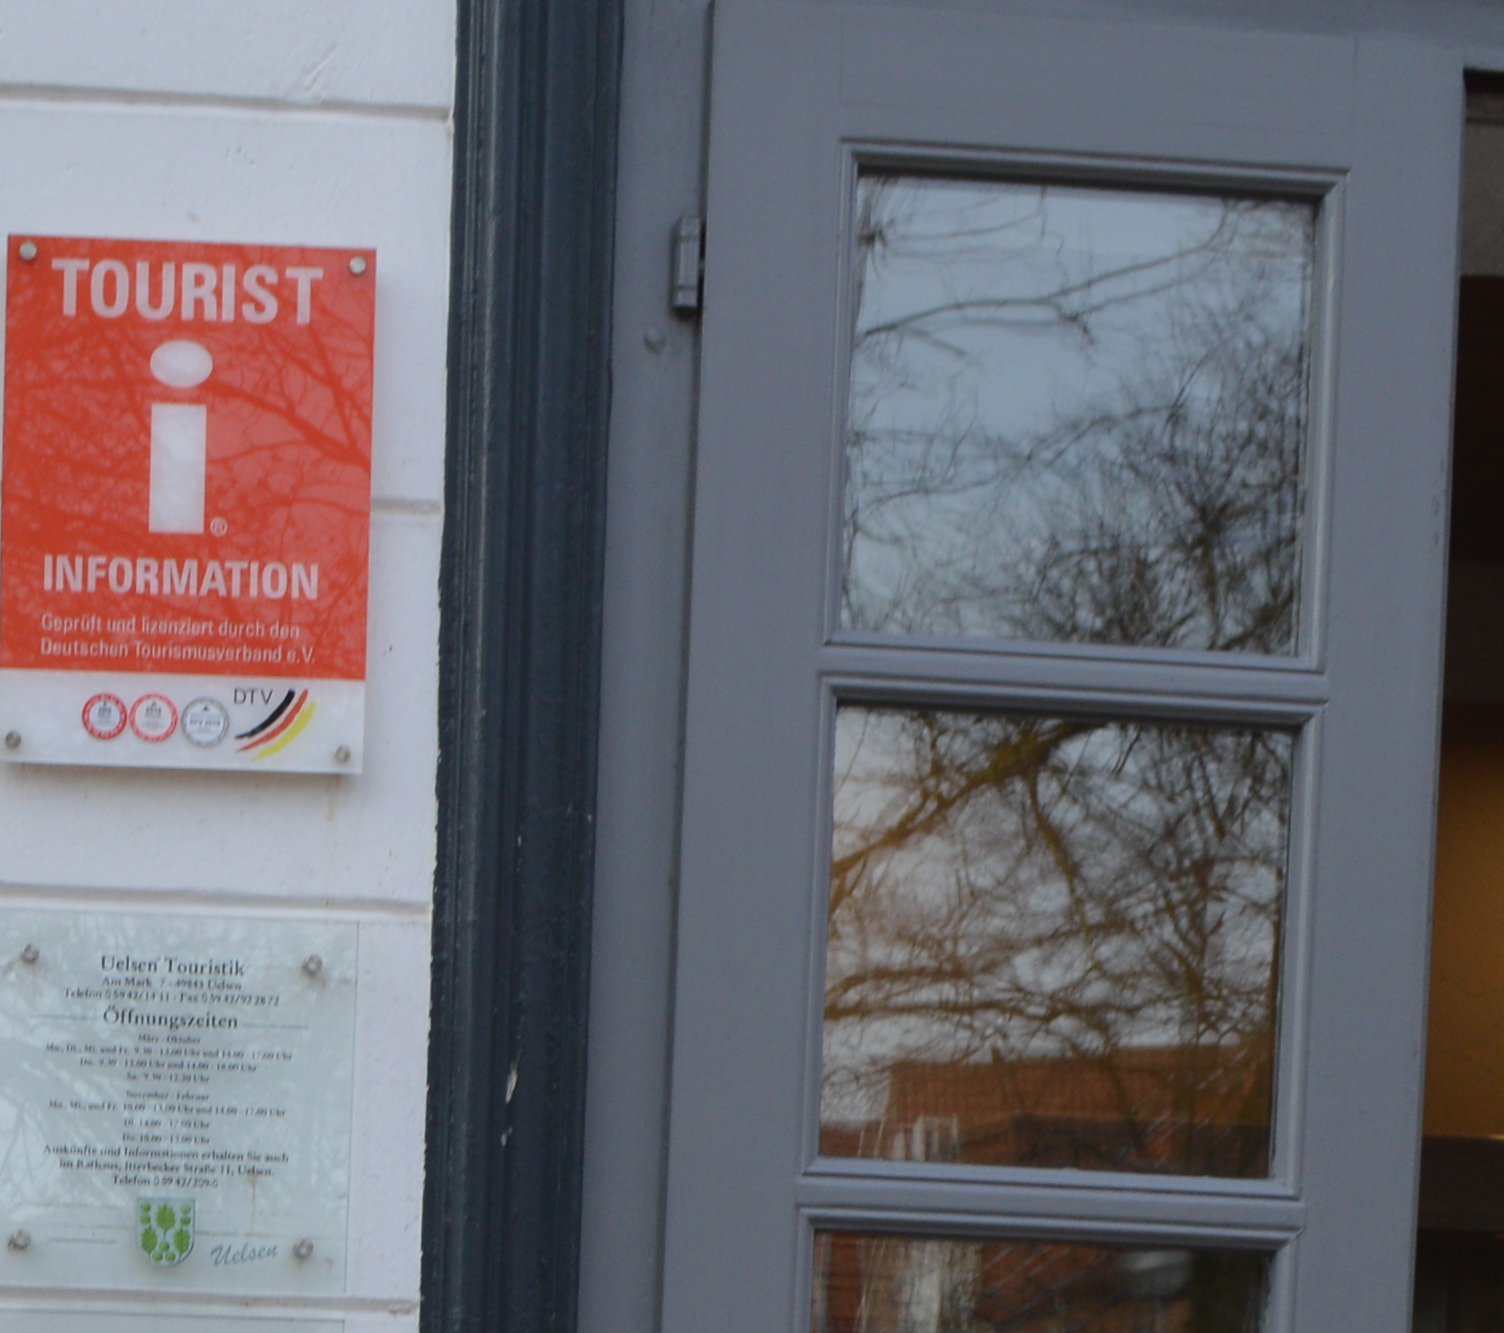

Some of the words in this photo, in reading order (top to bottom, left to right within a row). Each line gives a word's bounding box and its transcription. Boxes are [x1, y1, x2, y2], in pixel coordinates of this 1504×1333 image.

[51, 257, 324, 325] TOURIST
[43, 554, 319, 600] INFORMATION
[41, 613, 103, 634] Geprüft
[107, 615, 136, 634] und
[141, 616, 213, 637] lizenziert
[218, 618, 265, 639] durch
[269, 621, 300, 639] den
[40, 638, 129, 658] Deutschen
[134, 640, 282, 664] Tourismusverband
[233, 687, 273, 706] DTV
[100, 953, 157, 973] Uelsen
[163, 956, 243, 977] Touristik
[102, 1003, 237, 1030] Öffnungszeiten
[210, 1243, 278, 1266] Uelsen
